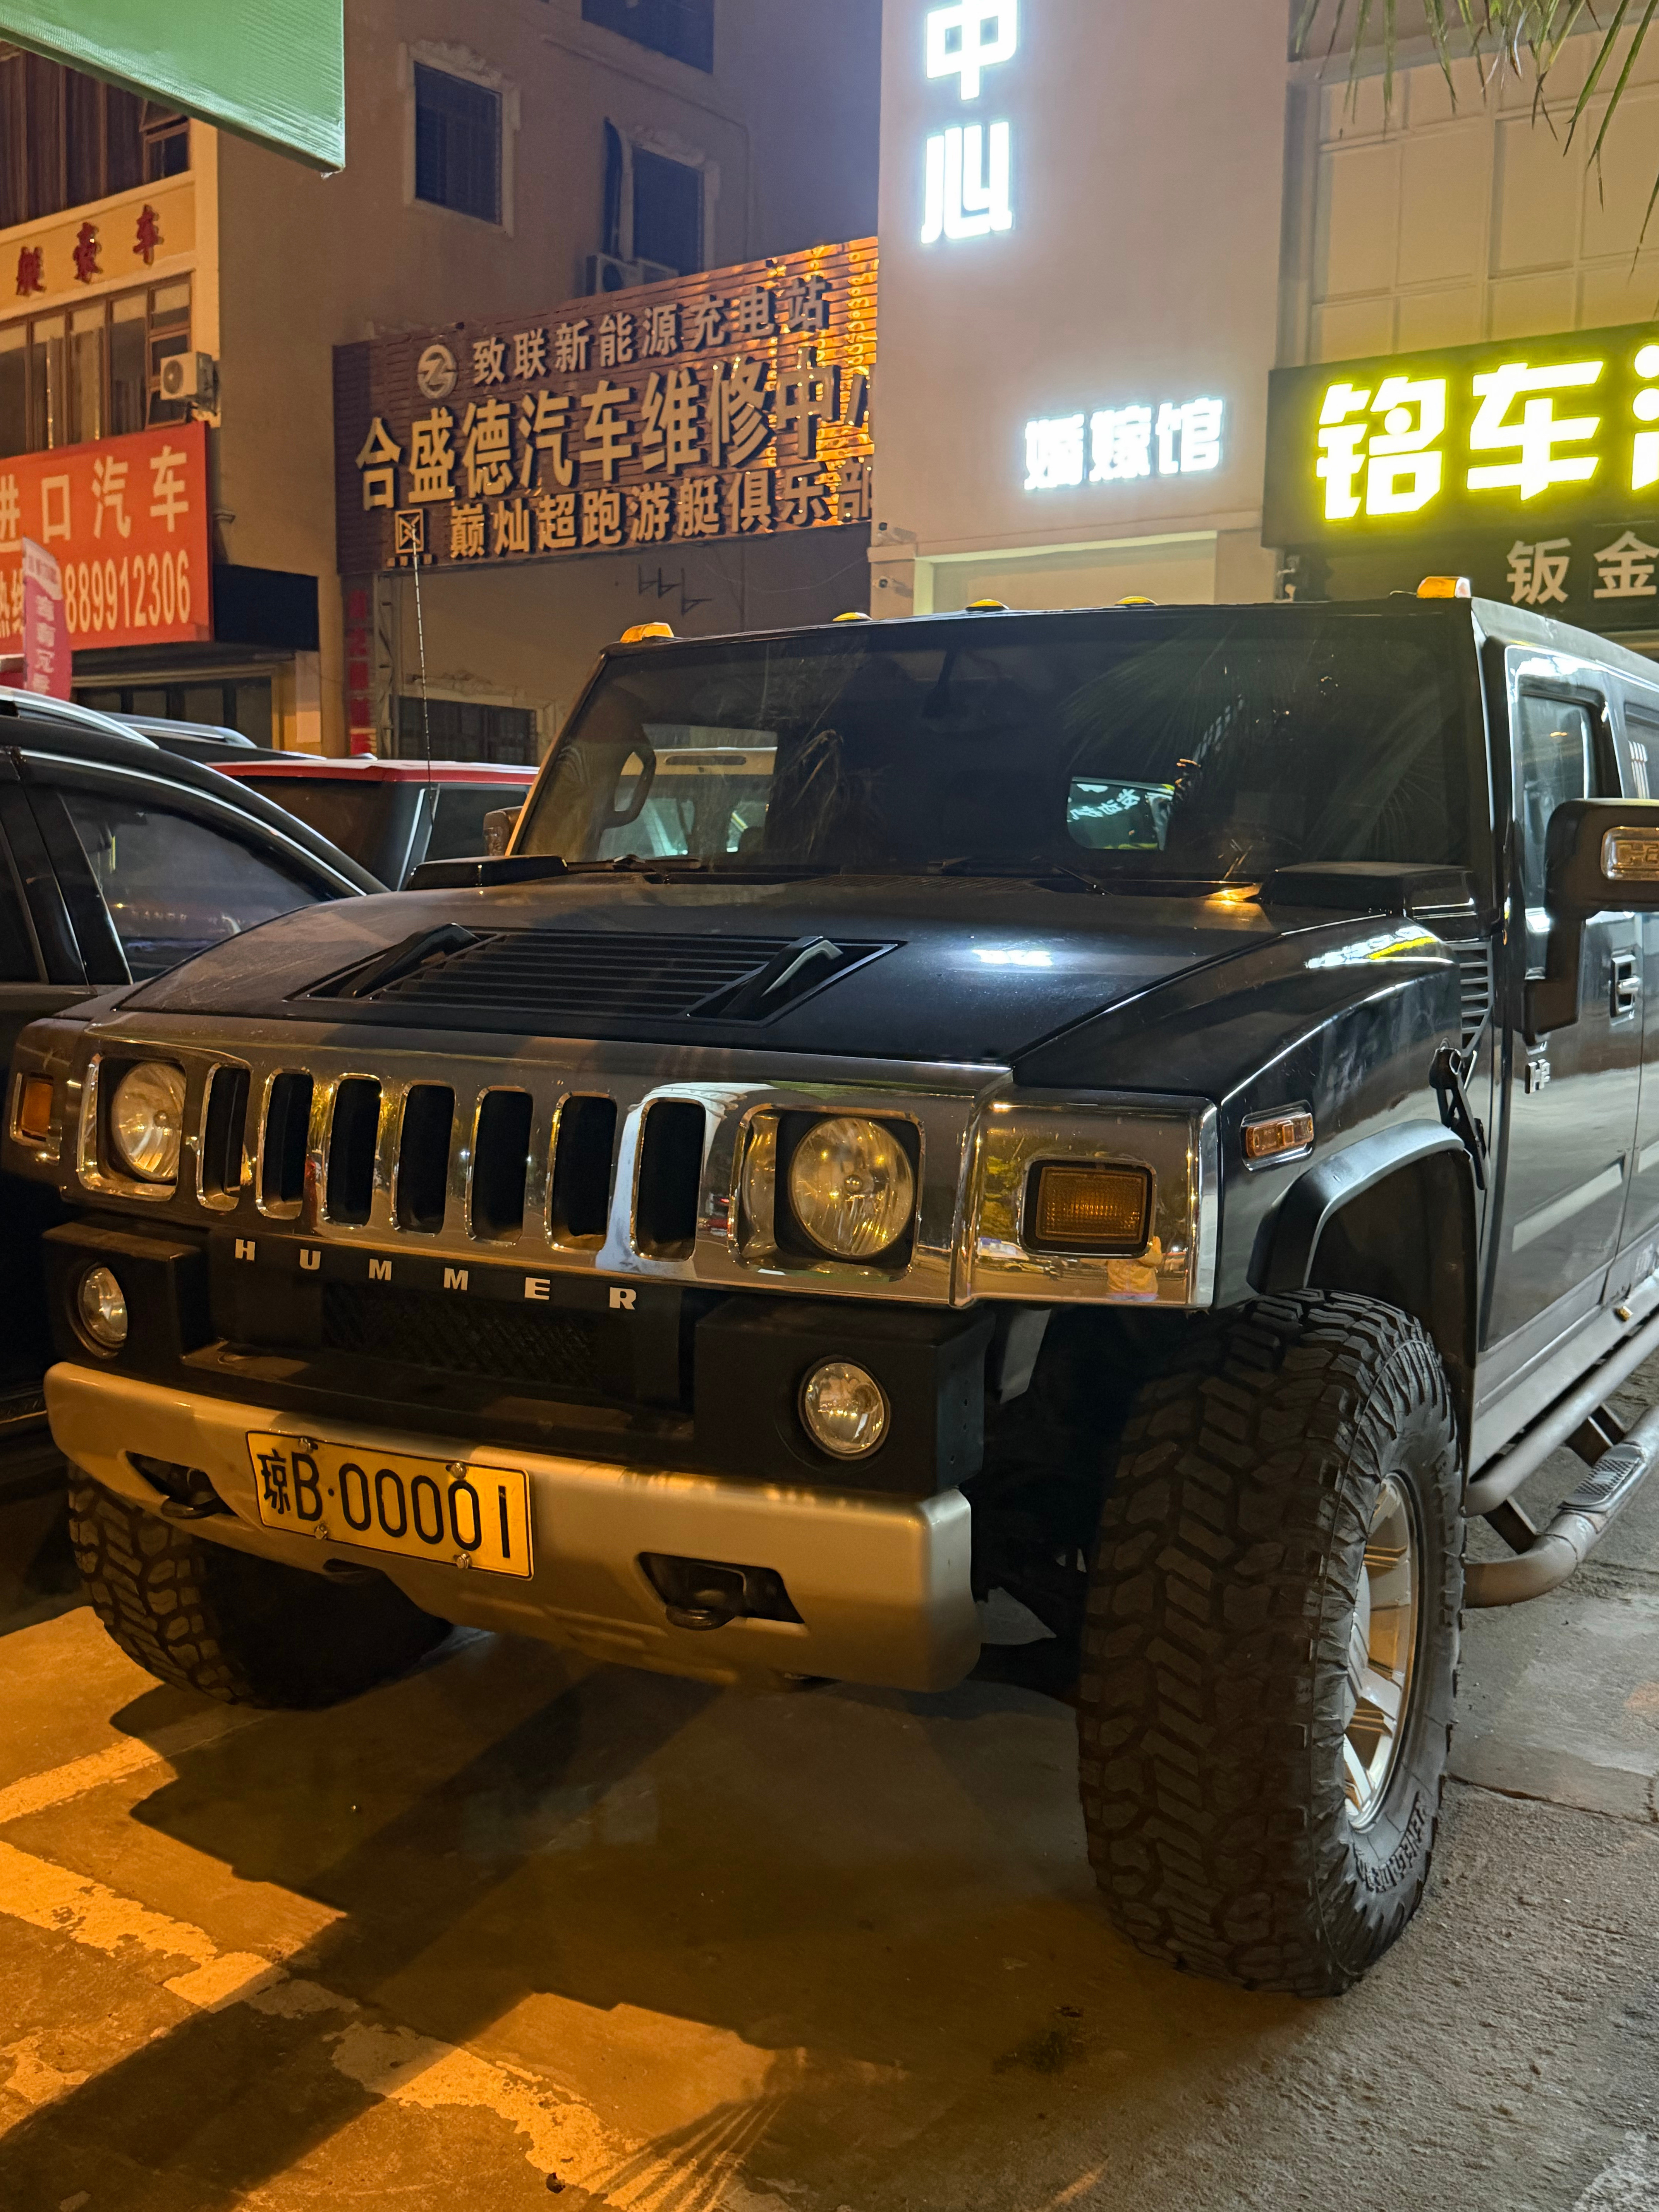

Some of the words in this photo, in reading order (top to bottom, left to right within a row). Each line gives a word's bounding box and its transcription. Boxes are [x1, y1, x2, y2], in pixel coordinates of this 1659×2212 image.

[921, 0, 1017, 243] 中心
[473, 275, 826, 384] 致联新能源充电站
[356, 347, 864, 511] 合盛德汽车维修中
[1317, 344, 1659, 519] 铭车
[1506, 531, 1659, 605] 钣金
[235, 1238, 637, 1310] HUMMER
[256, 1448, 510, 1558] 琼B·00001
